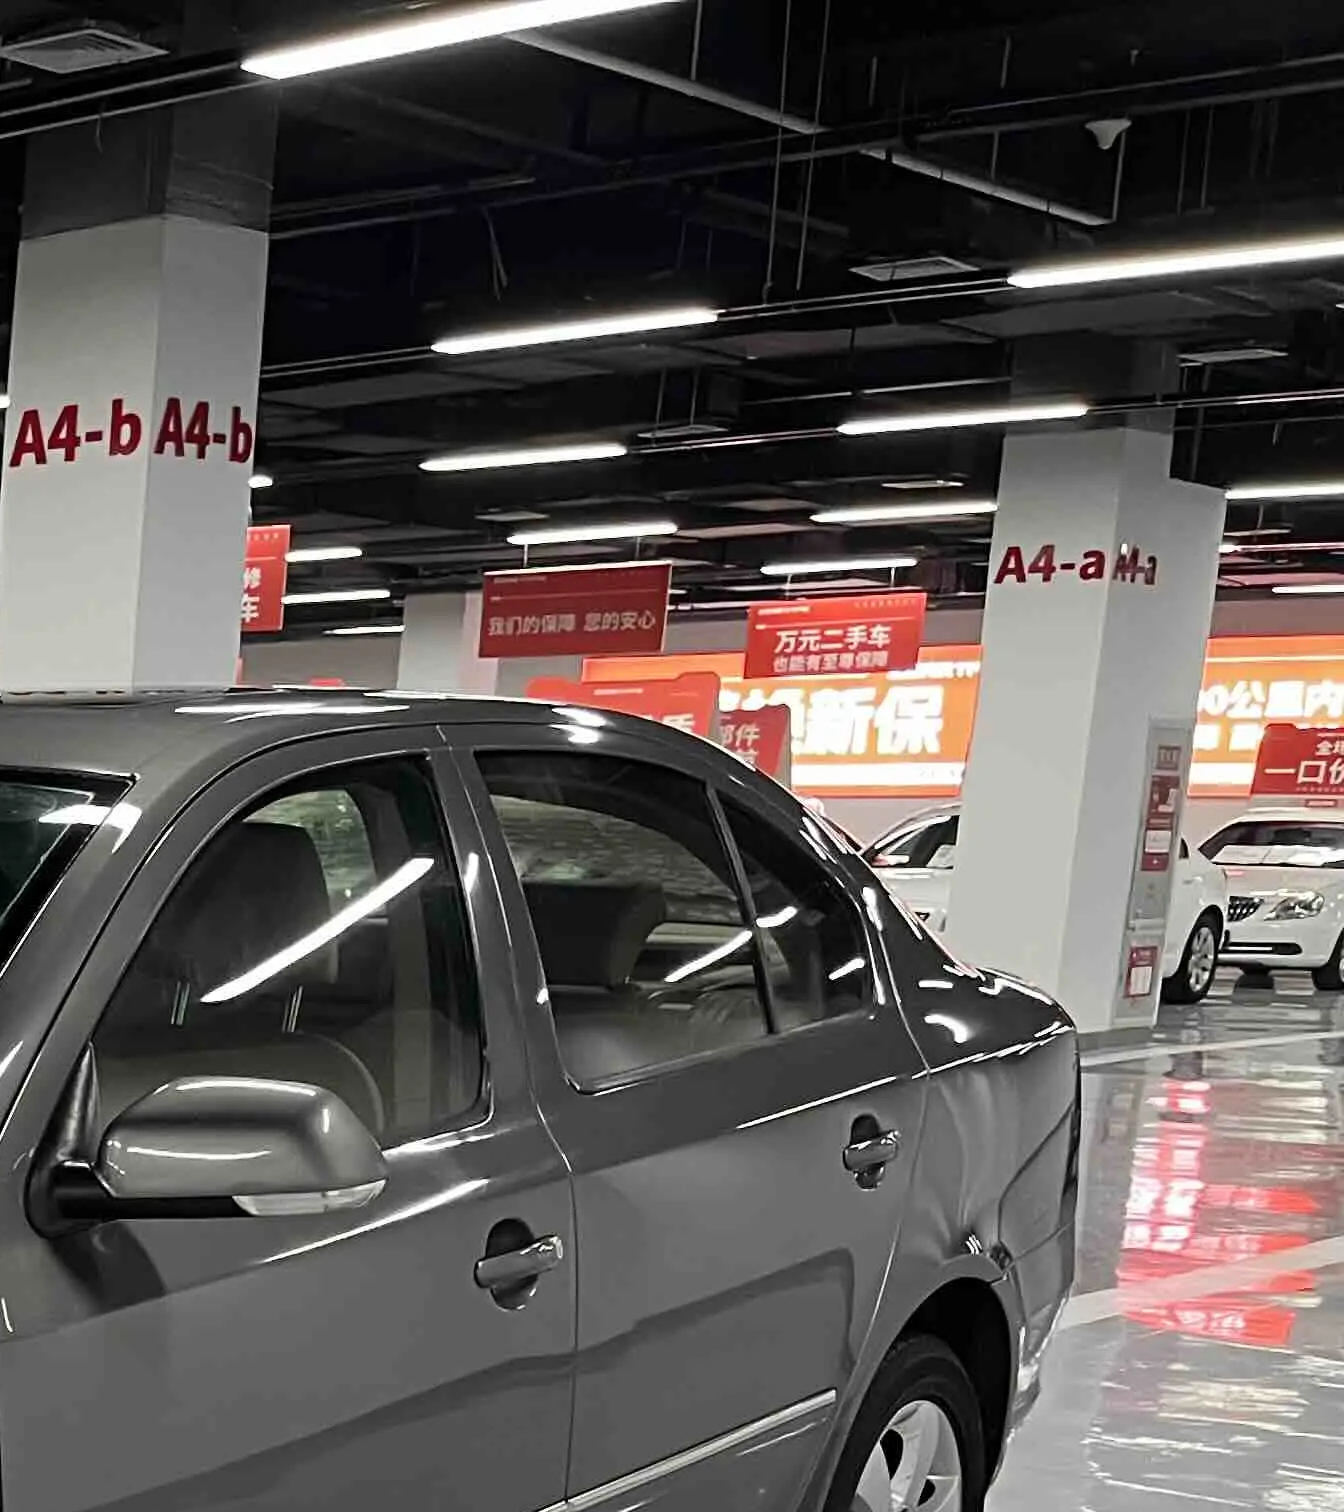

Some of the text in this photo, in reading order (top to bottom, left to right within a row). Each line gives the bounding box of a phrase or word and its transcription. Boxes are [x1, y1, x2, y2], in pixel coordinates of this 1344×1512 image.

[9, 396, 253, 467] A4-b A4-b
[994, 544, 1106, 584] A4-a
[241, 593, 260, 623] 车
[488, 610, 656, 636] 我们的保障 您的安心
[774, 624, 891, 653] 万元二手车
